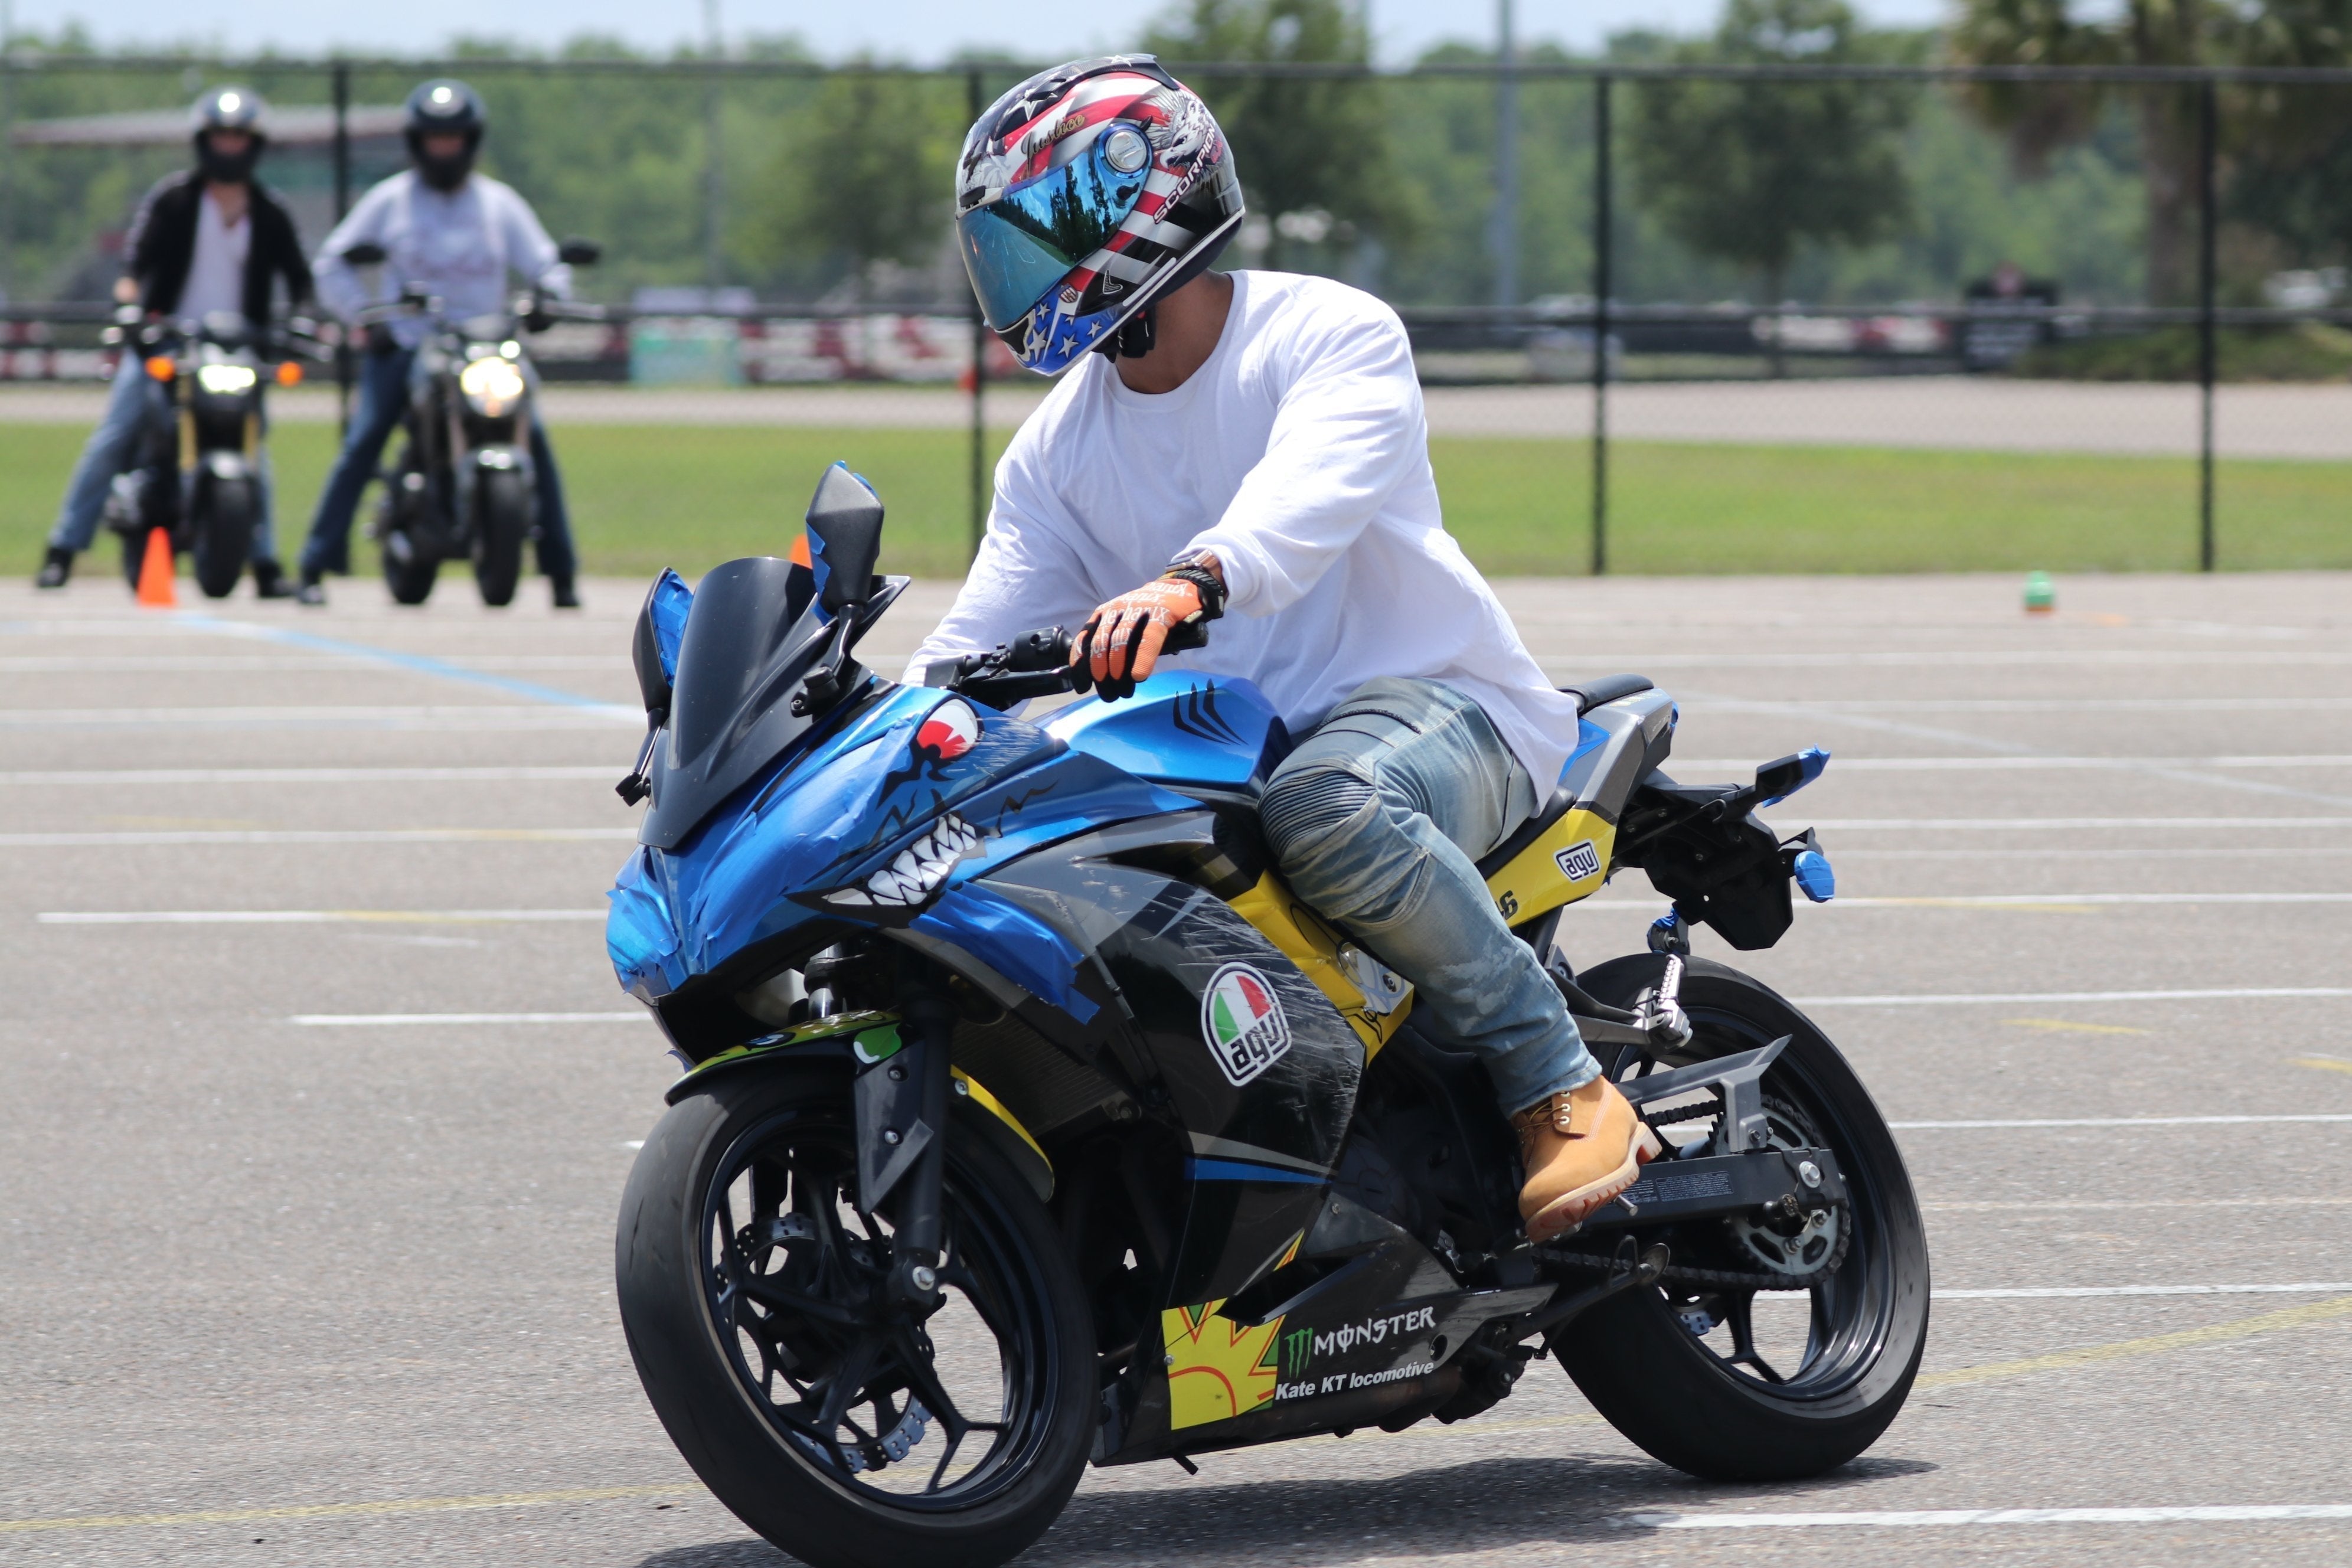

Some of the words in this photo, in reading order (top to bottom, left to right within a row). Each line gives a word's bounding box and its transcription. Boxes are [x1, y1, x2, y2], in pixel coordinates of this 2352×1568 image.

[1021, 115, 1085, 179] Justice
[1153, 123, 1215, 224] SCORPION
[1564, 850, 1594, 876] agv
[1495, 890, 1518, 920] 6
[1314, 1306, 1436, 1355] MONSTER
[1275, 1381, 1316, 1400] Kate
[1321, 1374, 1347, 1393] KT
[1349, 1361, 1434, 1389] locomotive
